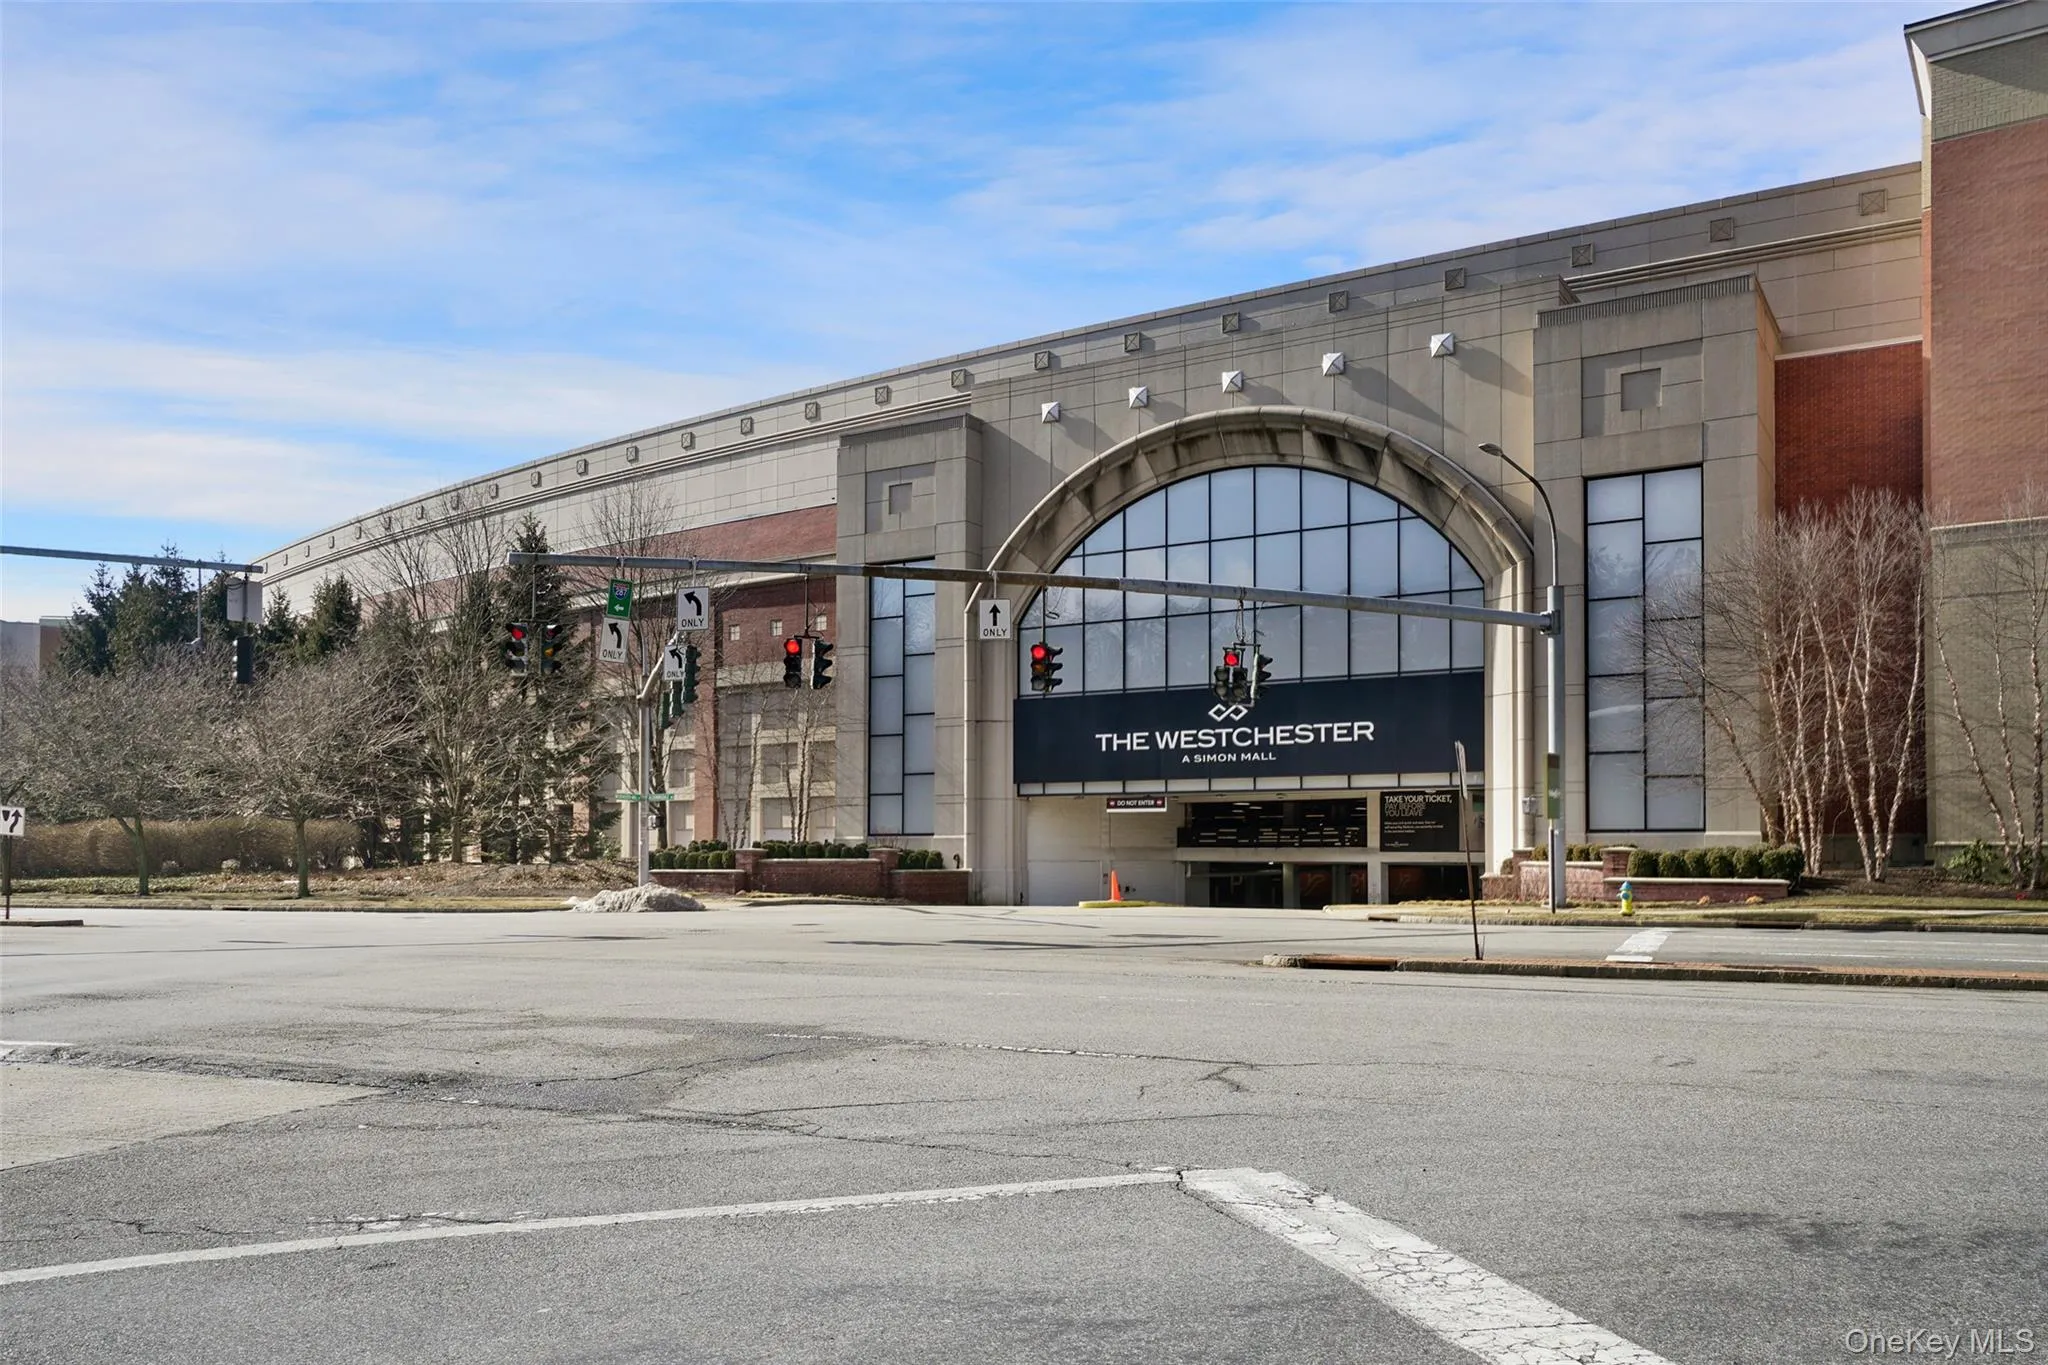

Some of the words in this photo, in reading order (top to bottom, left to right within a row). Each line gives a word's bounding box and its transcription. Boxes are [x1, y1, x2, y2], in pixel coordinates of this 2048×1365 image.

[681, 618, 704, 628] ONLY
[983, 628, 1007, 637] ONLY
[602, 649, 623, 659] ONLY
[666, 670, 684, 679] ONLY
[1095, 732, 1150, 752] THE
[1155, 721, 1375, 750] WESTCHESTER
[1181, 755, 1191, 763] A
[1194, 753, 1237, 763] SIMON
[1241, 752, 1277, 762] MALL
[1384, 795, 1403, 803] TAKE
[1403, 795, 1424, 803] YOUR
[1425, 795, 1453, 803] TICKET,
[1401, 809, 1424, 817] LEAVE
